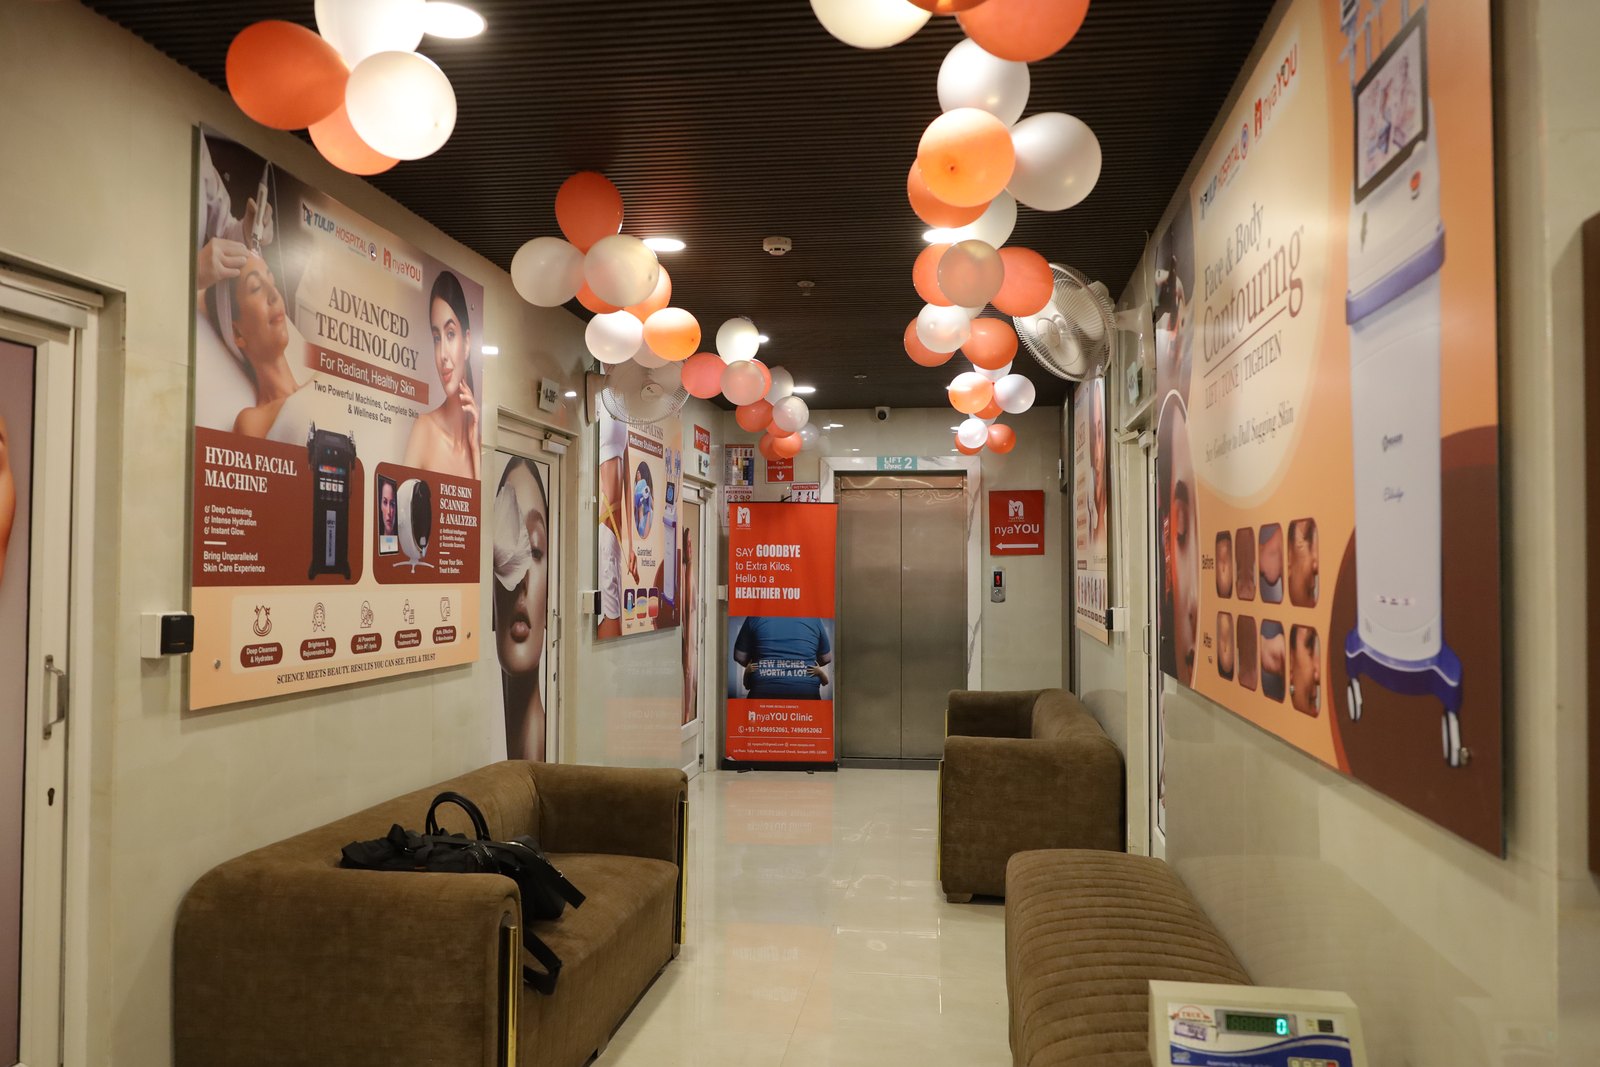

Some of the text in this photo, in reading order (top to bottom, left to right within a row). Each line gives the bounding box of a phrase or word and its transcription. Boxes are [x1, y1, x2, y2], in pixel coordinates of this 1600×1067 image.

[314, 213, 367, 253] TULIP HOSPITAL
[1204, 202, 1264, 302] Face & Body
[392, 259, 420, 282] nyaYOU
[1204, 230, 1303, 363] Contouring
[328, 286, 409, 338] ADVANCED
[316, 312, 419, 370] TECHNOLOGY
[1244, 330, 1282, 381] TIGHTEN
[320, 352, 416, 397] For Radiant, Healthy Skin
[314, 380, 326, 393] Two
[328, 384, 354, 400] Powerful
[384, 401, 408, 417] Complete
[408, 408, 419, 419] Skin
[348, 404, 392, 424] & Wellness Care
[205, 446, 297, 476] HYDRA FACIAL
[904, 457, 912, 469] 2
[204, 469, 267, 493] MACHINE
[440, 483, 472, 498] FACE SKIN
[211, 505, 252, 517] Deep Cleansing
[440, 498, 469, 512] SCANNER
[211, 516, 256, 527] Intense Hydration
[440, 513, 477, 527] & ANALYZER
[211, 526, 230, 535] Instant
[994, 524, 1040, 536] nyaYOU
[204, 551, 258, 562] Bring Unparalleled
[736, 544, 800, 557] SAY GOODBYE
[203, 562, 265, 574] Skin Care Experience
[736, 562, 792, 572] to Extra Kilos,
[736, 574, 756, 583] Hello
[759, 574, 767, 583] to
[736, 587, 800, 599] HEALTHIER YOU
[255, 655, 273, 664] Hydrates
[759, 660, 774, 668] FEW
[277, 672, 304, 684] SCIENCE
[306, 669, 326, 680] MEETS
[351, 662, 373, 673] RESULTS
[374, 660, 384, 669] YOU
[385, 659, 394, 667] CAN
[406, 656, 418, 664] FEEL
[422, 653, 436, 661] TRUST
[756, 713, 813, 722] nyaYOU Clinic
[1276, 1018, 1287, 1035] 0
